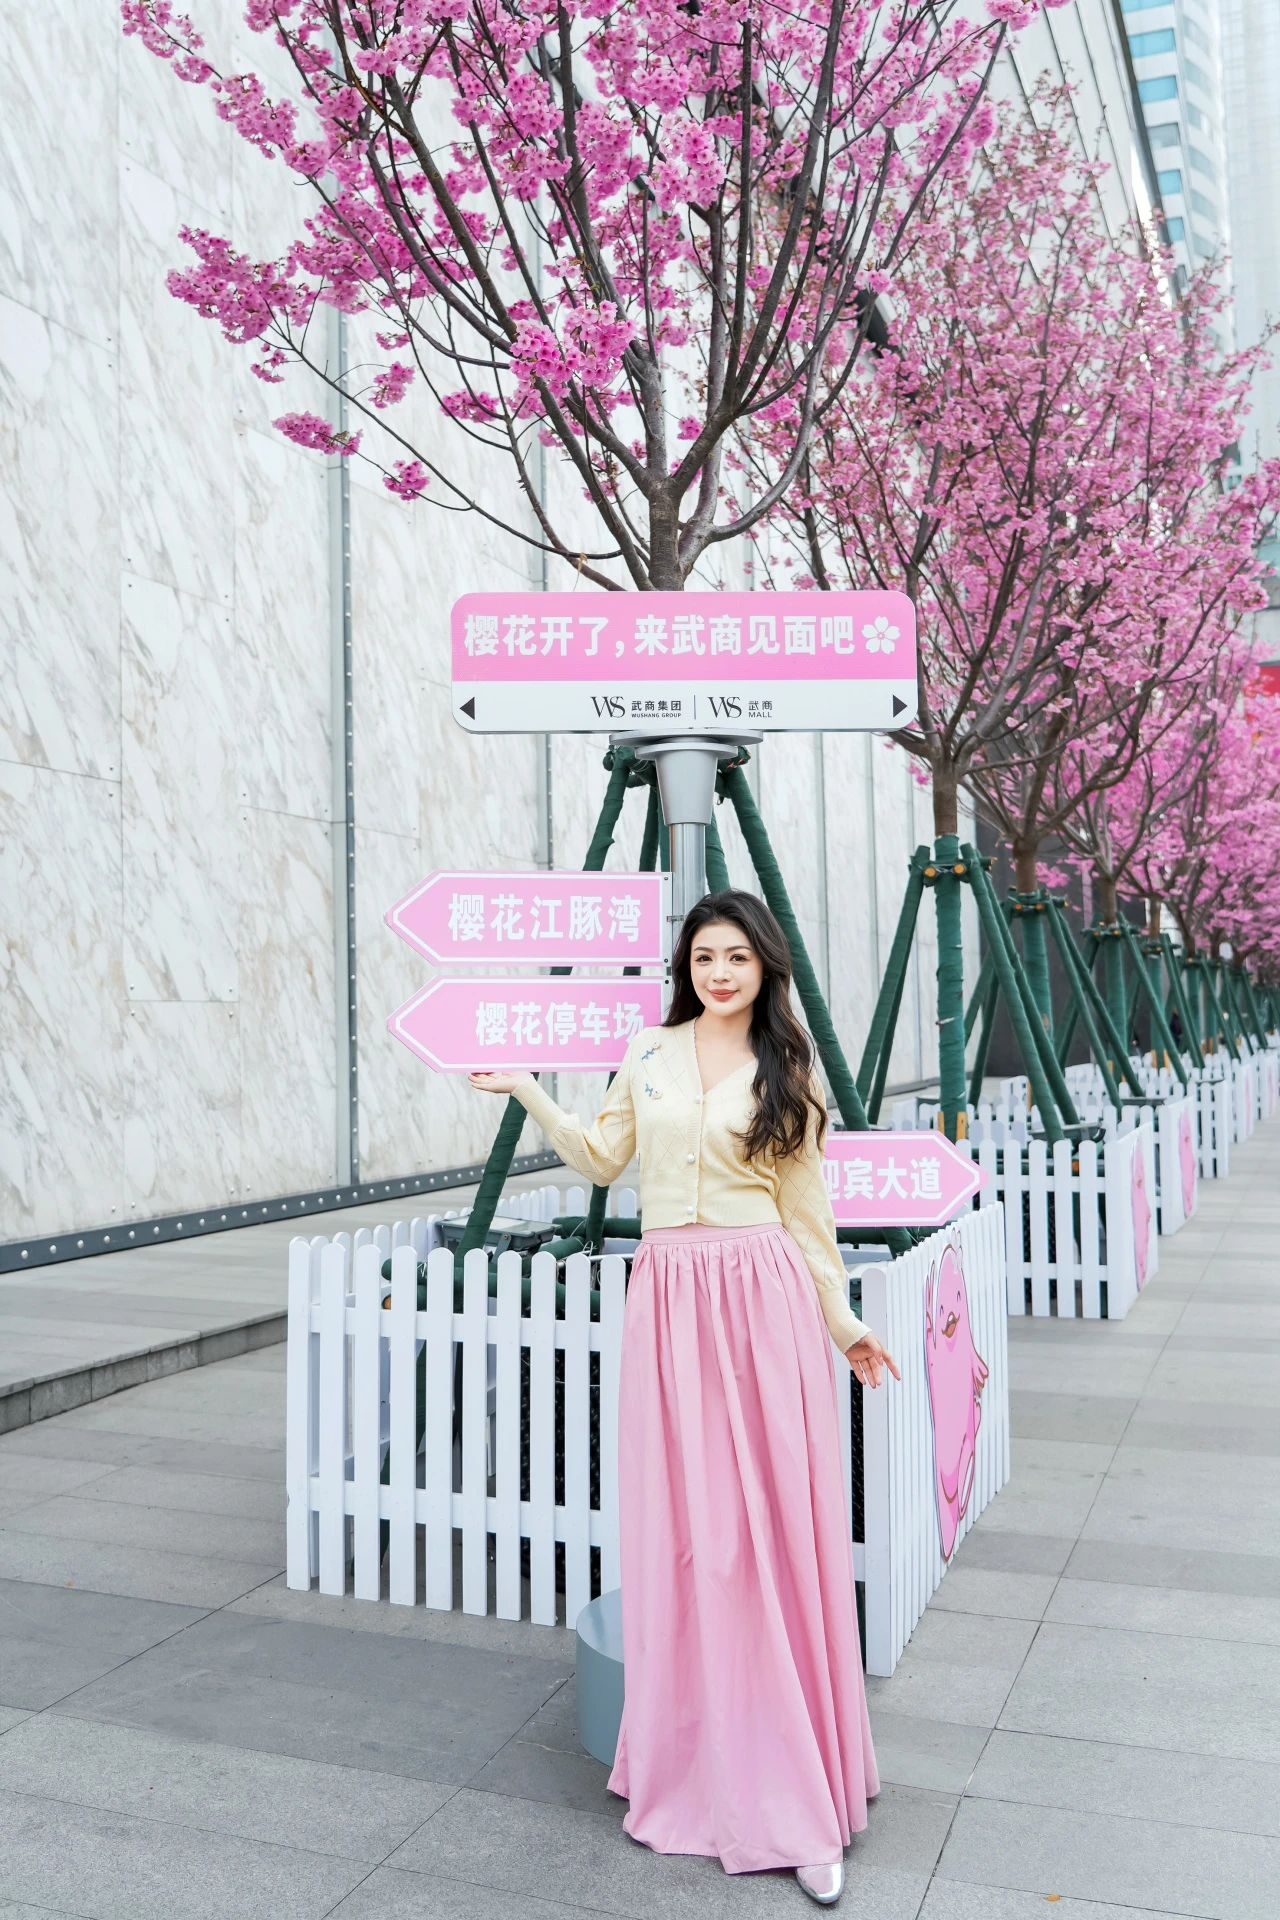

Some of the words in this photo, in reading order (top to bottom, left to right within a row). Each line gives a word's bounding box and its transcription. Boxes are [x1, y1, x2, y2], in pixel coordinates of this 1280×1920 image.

[590, 696, 626, 718] WS
[631, 700, 682, 711] 武商集团
[707, 696, 742, 718] WS
[748, 700, 773, 711] 武商
[448, 893, 642, 942] 樱花江豚湾
[475, 1002, 644, 1046] 樱花停车场
